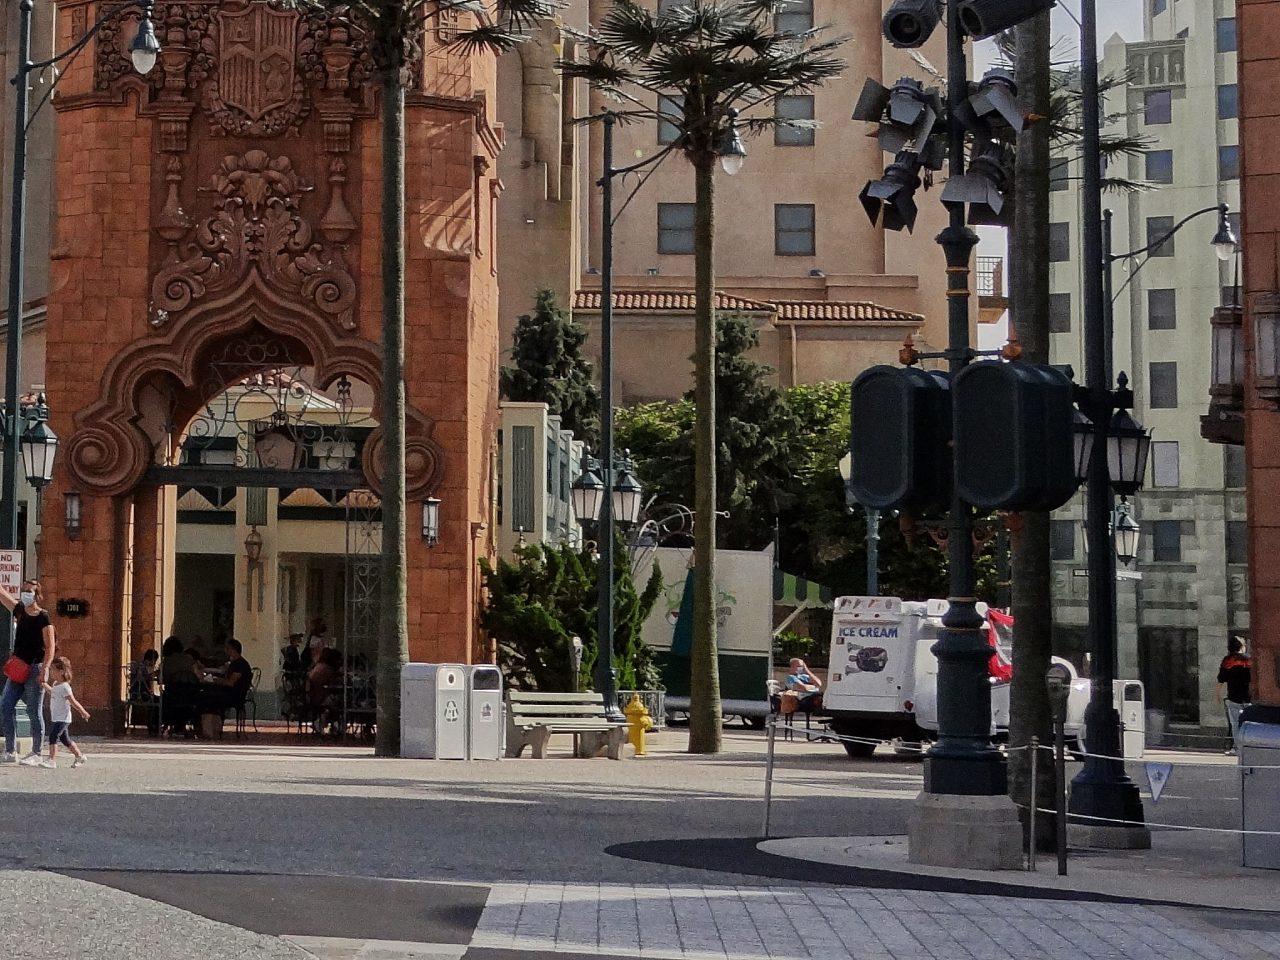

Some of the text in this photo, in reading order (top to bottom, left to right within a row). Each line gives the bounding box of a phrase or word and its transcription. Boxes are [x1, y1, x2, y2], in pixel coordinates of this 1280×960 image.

[0, 554, 12, 562] NO
[1, 574, 10, 583] IN
[838, 627, 898, 638] ICE CREAM
